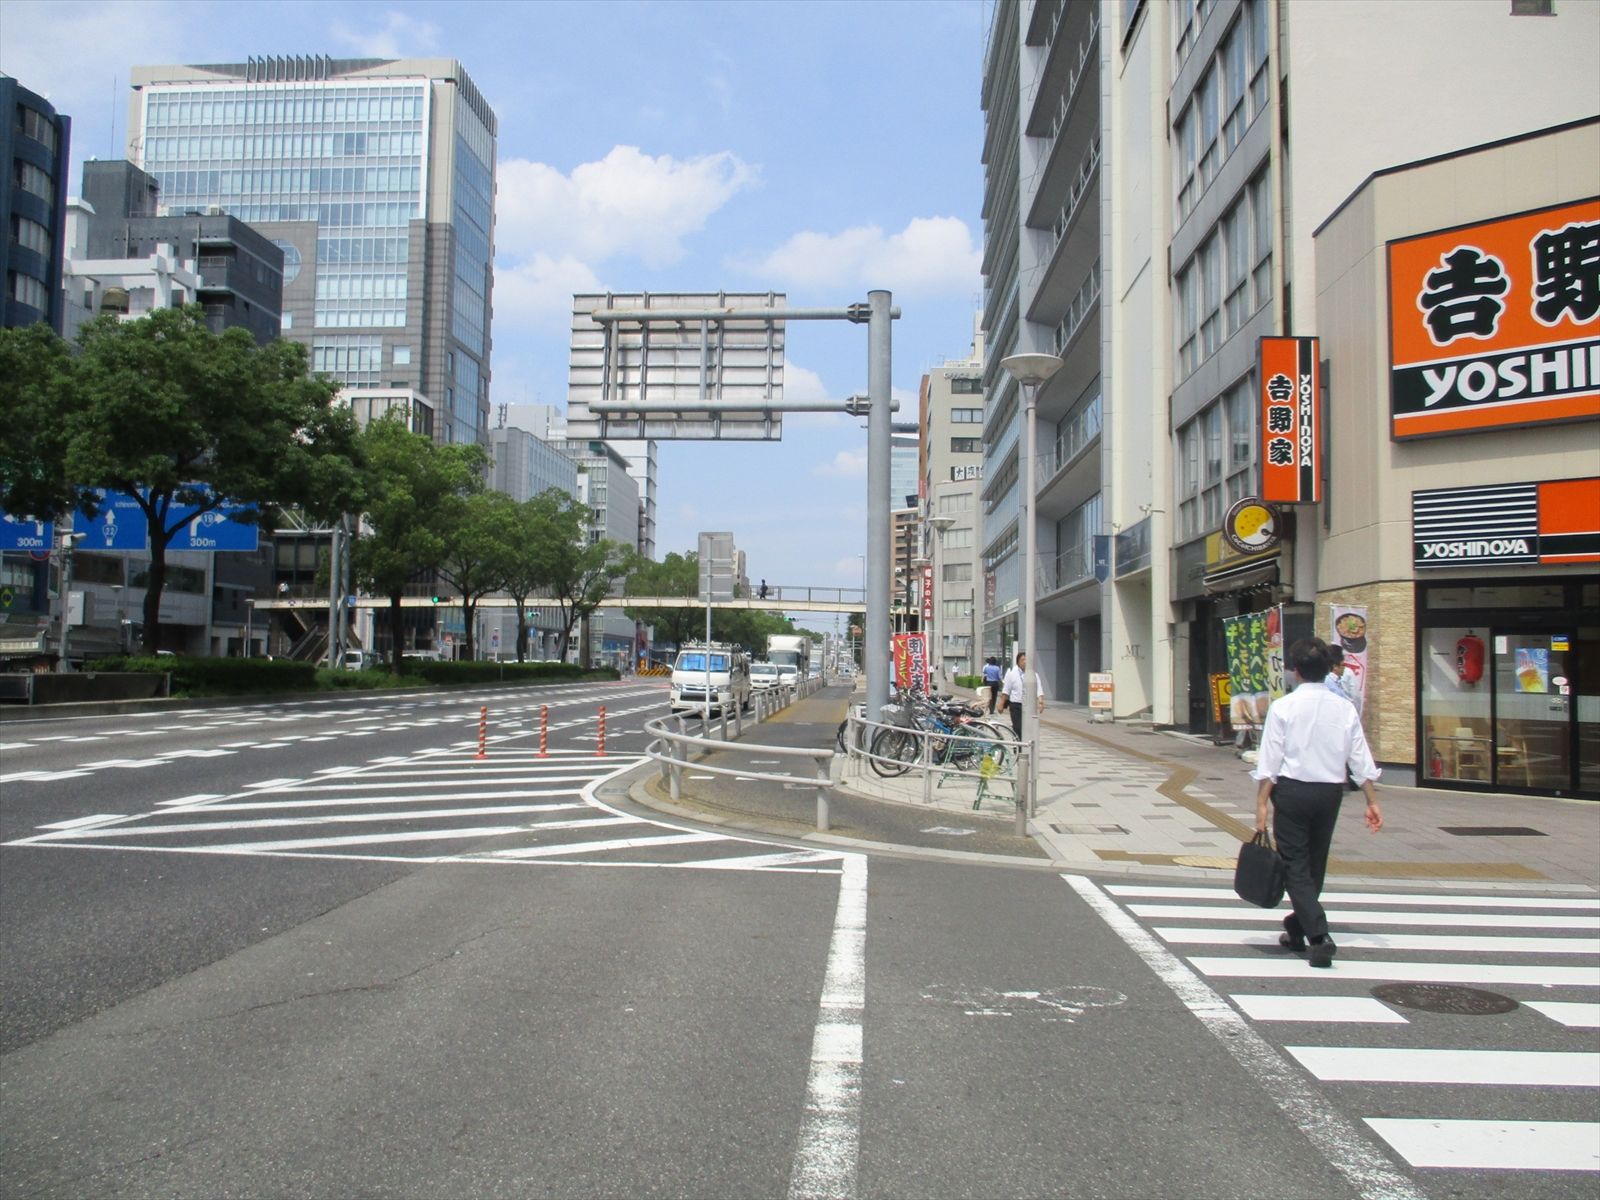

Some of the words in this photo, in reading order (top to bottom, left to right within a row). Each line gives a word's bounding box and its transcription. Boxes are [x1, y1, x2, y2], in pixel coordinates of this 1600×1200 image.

[1266, 373, 1294, 467] 吉野家
[1300, 374, 1312, 467] YOSHINOYA
[203, 513, 213, 523] 19
[105, 527, 116, 537] 22
[17, 537, 43, 547] 300m
[190, 537, 216, 547] 300m
[1423, 539, 1529, 558] YOSHINOYA
